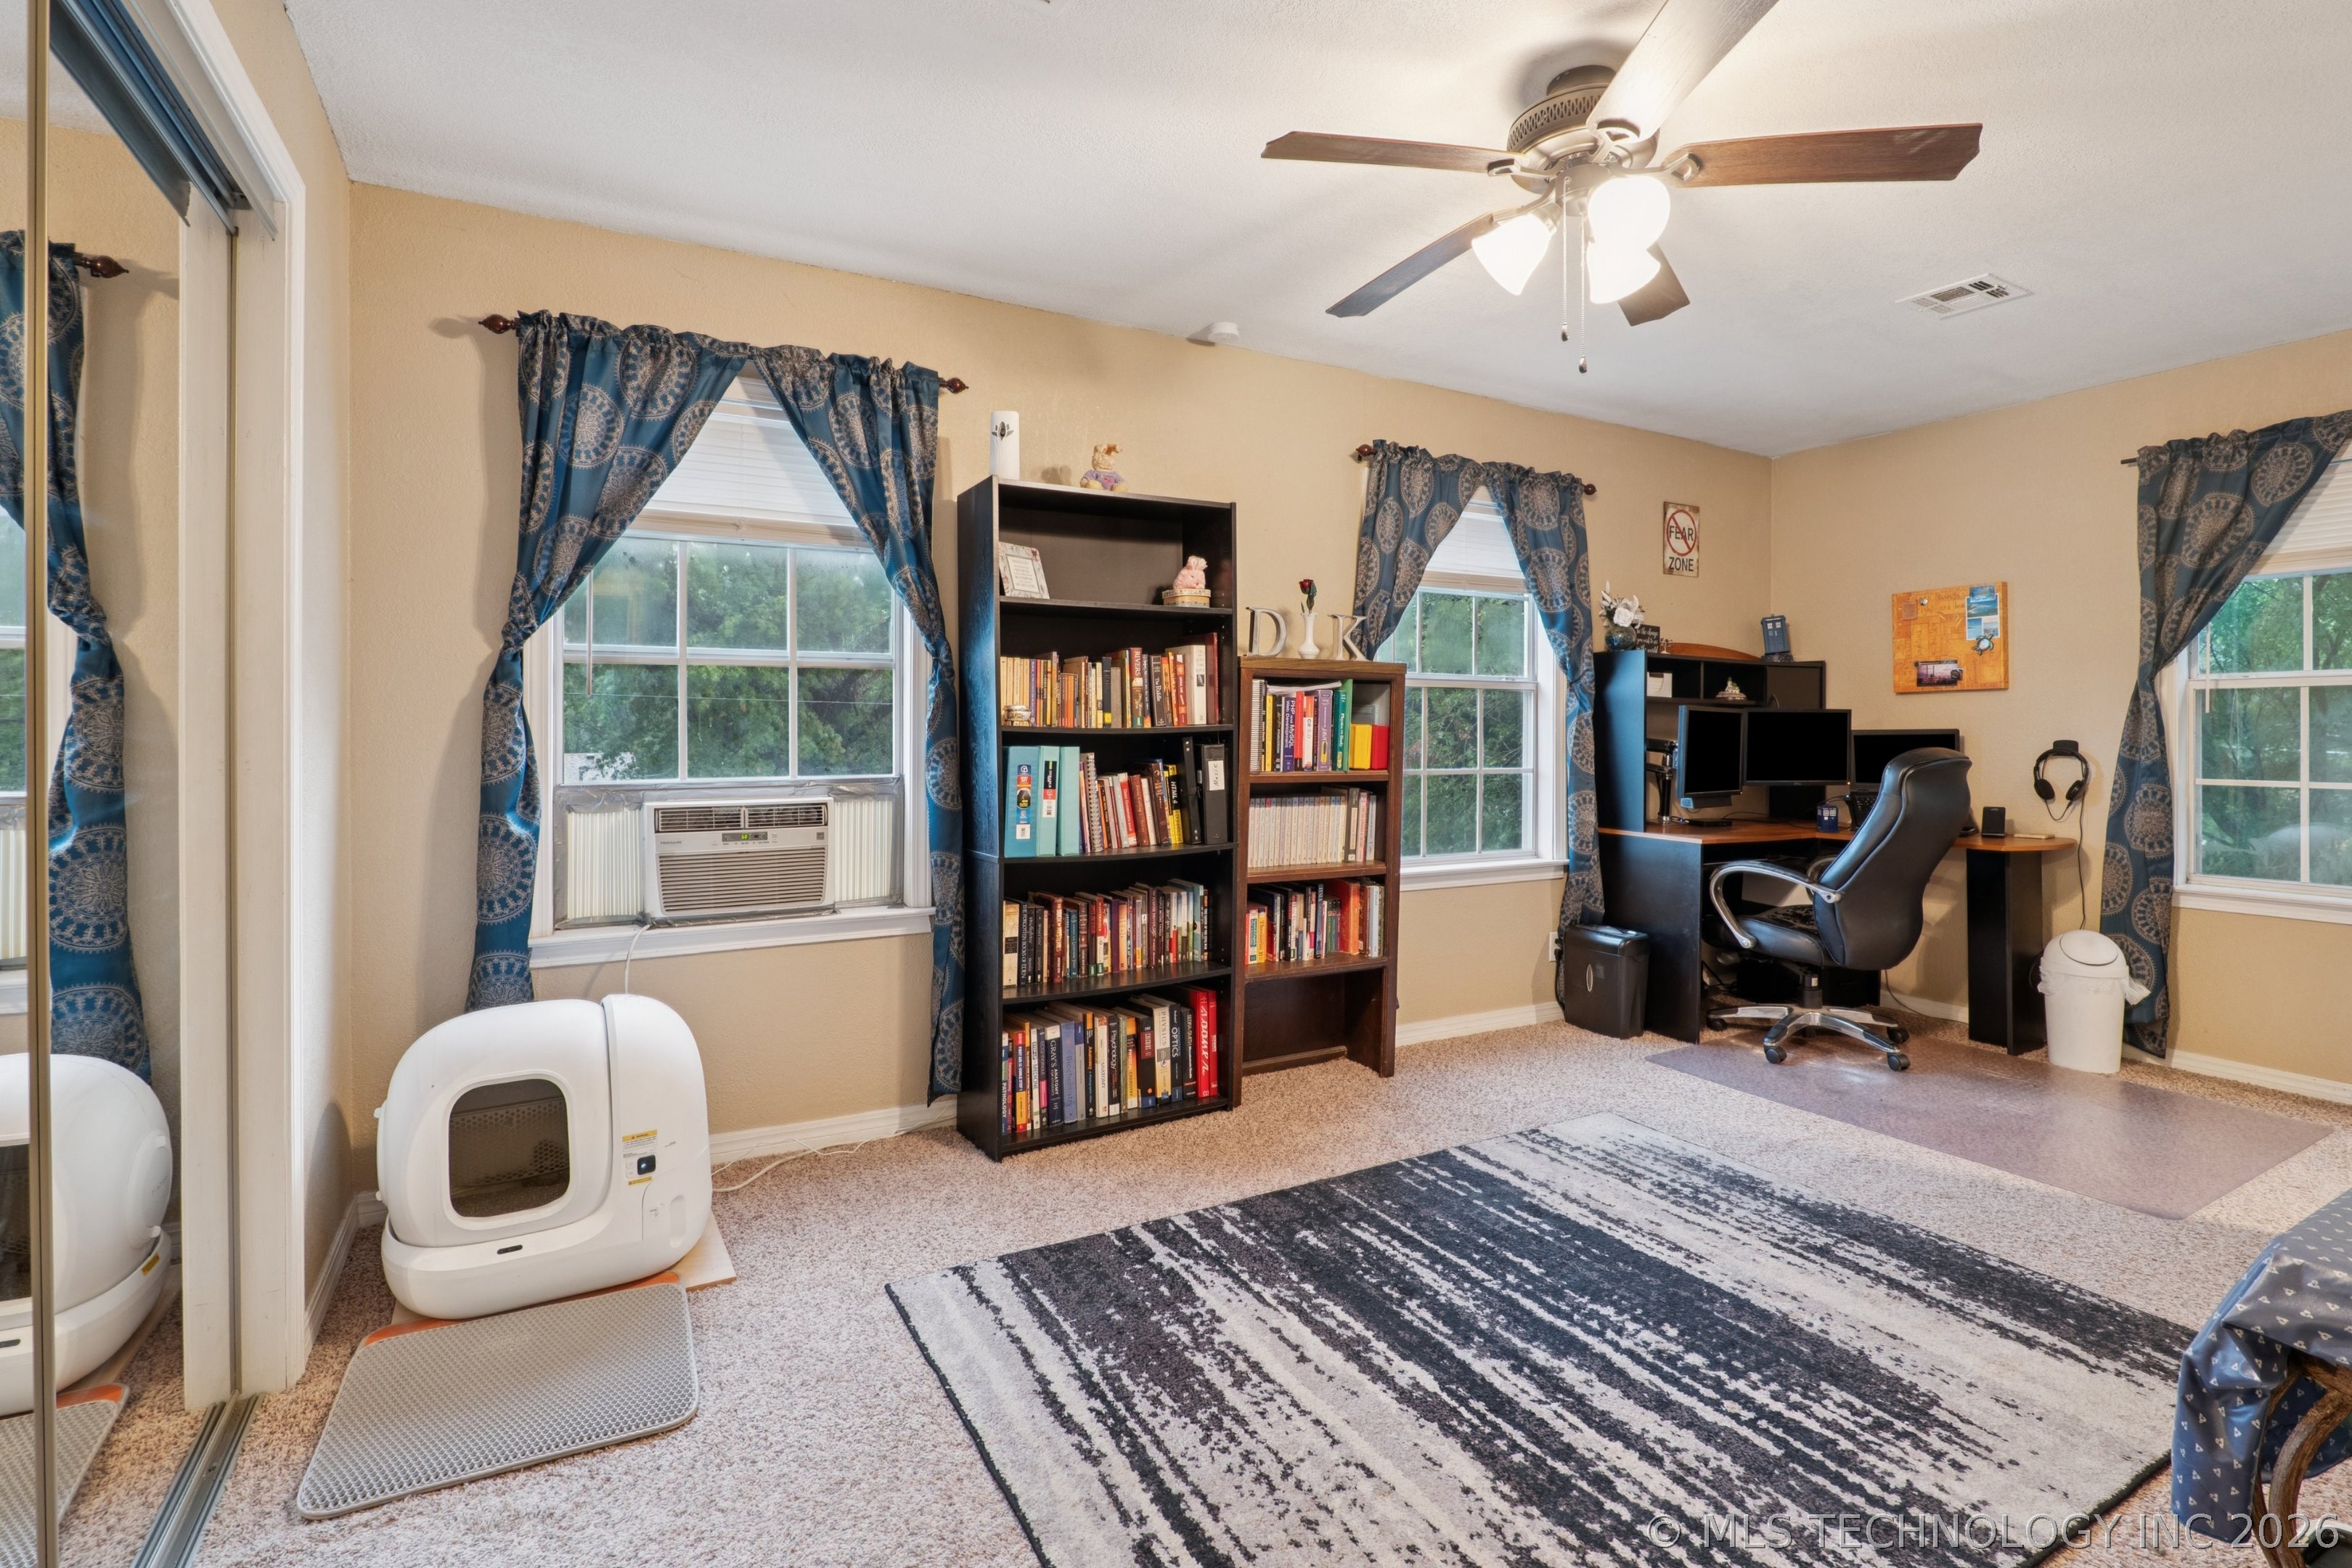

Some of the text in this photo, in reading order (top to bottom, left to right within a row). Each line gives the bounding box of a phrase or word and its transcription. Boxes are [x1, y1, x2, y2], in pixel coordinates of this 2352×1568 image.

[1670, 526, 1694, 541] FEAR
[1669, 557, 1694, 571] ZONE
[1244, 606, 1287, 658] D
[1328, 614, 1373, 662] K
